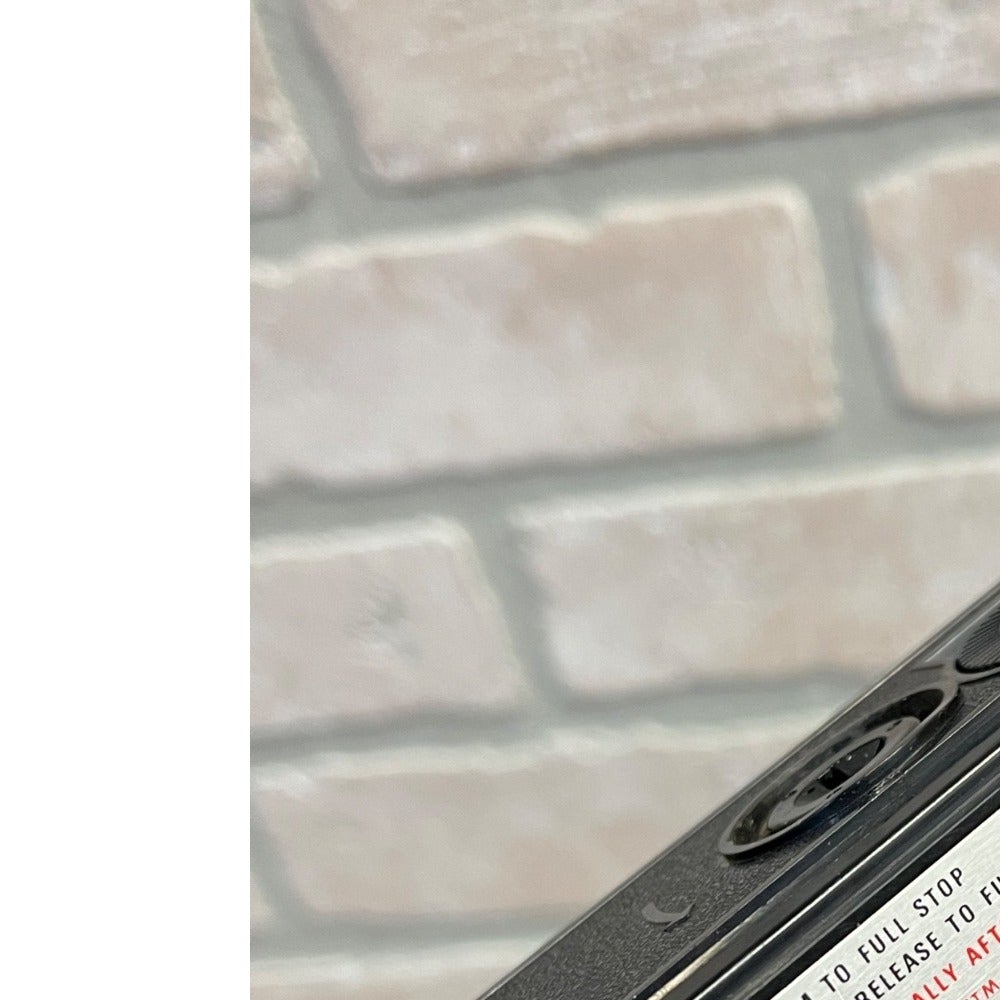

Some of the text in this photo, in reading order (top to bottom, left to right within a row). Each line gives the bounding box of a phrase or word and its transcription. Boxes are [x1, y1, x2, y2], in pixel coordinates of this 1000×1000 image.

[819, 964, 851, 993] TO
[857, 918, 909, 964] FULL
[913, 868, 962, 917] STOP
[944, 904, 975, 932] TO
